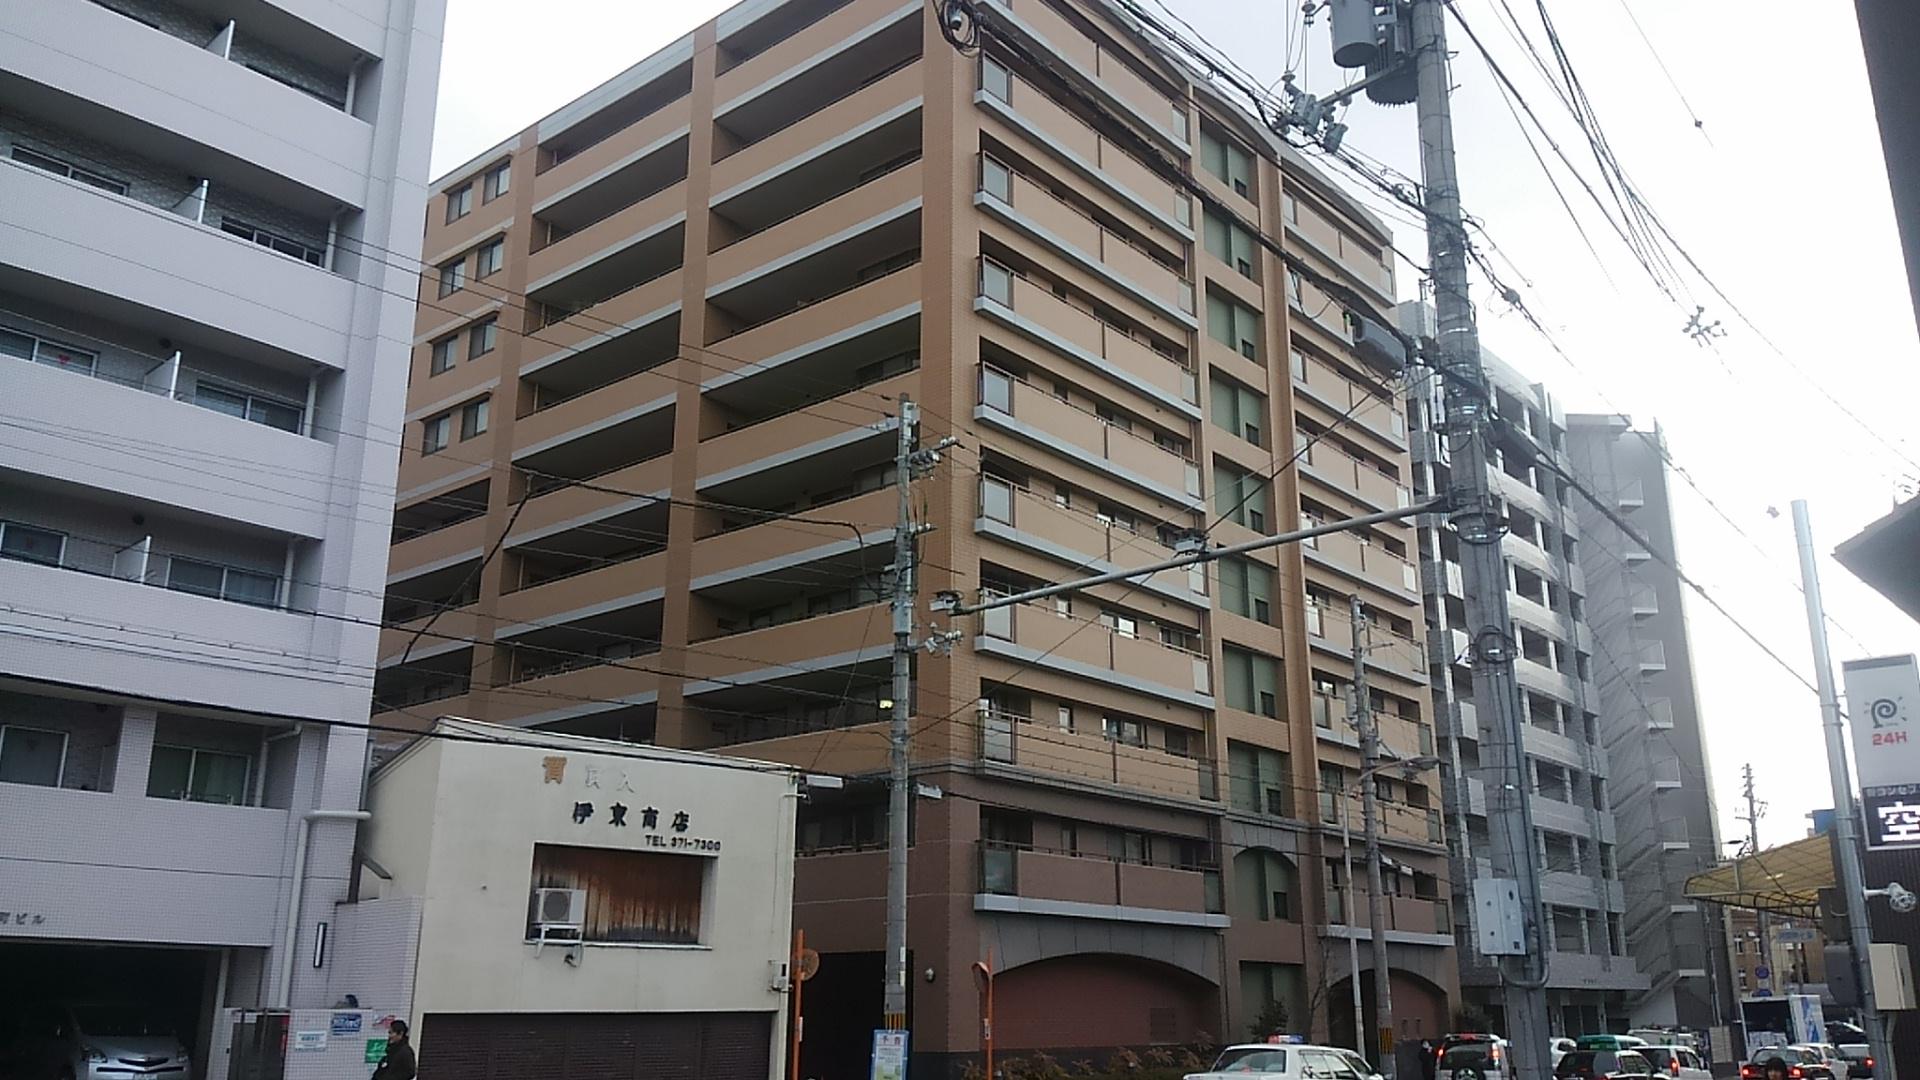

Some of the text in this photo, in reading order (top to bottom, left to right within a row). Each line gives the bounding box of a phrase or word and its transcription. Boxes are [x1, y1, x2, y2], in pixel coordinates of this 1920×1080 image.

[1872, 731, 1907, 746] 24H
[572, 801, 690, 832] 伊東商店
[645, 835, 666, 847] TEL
